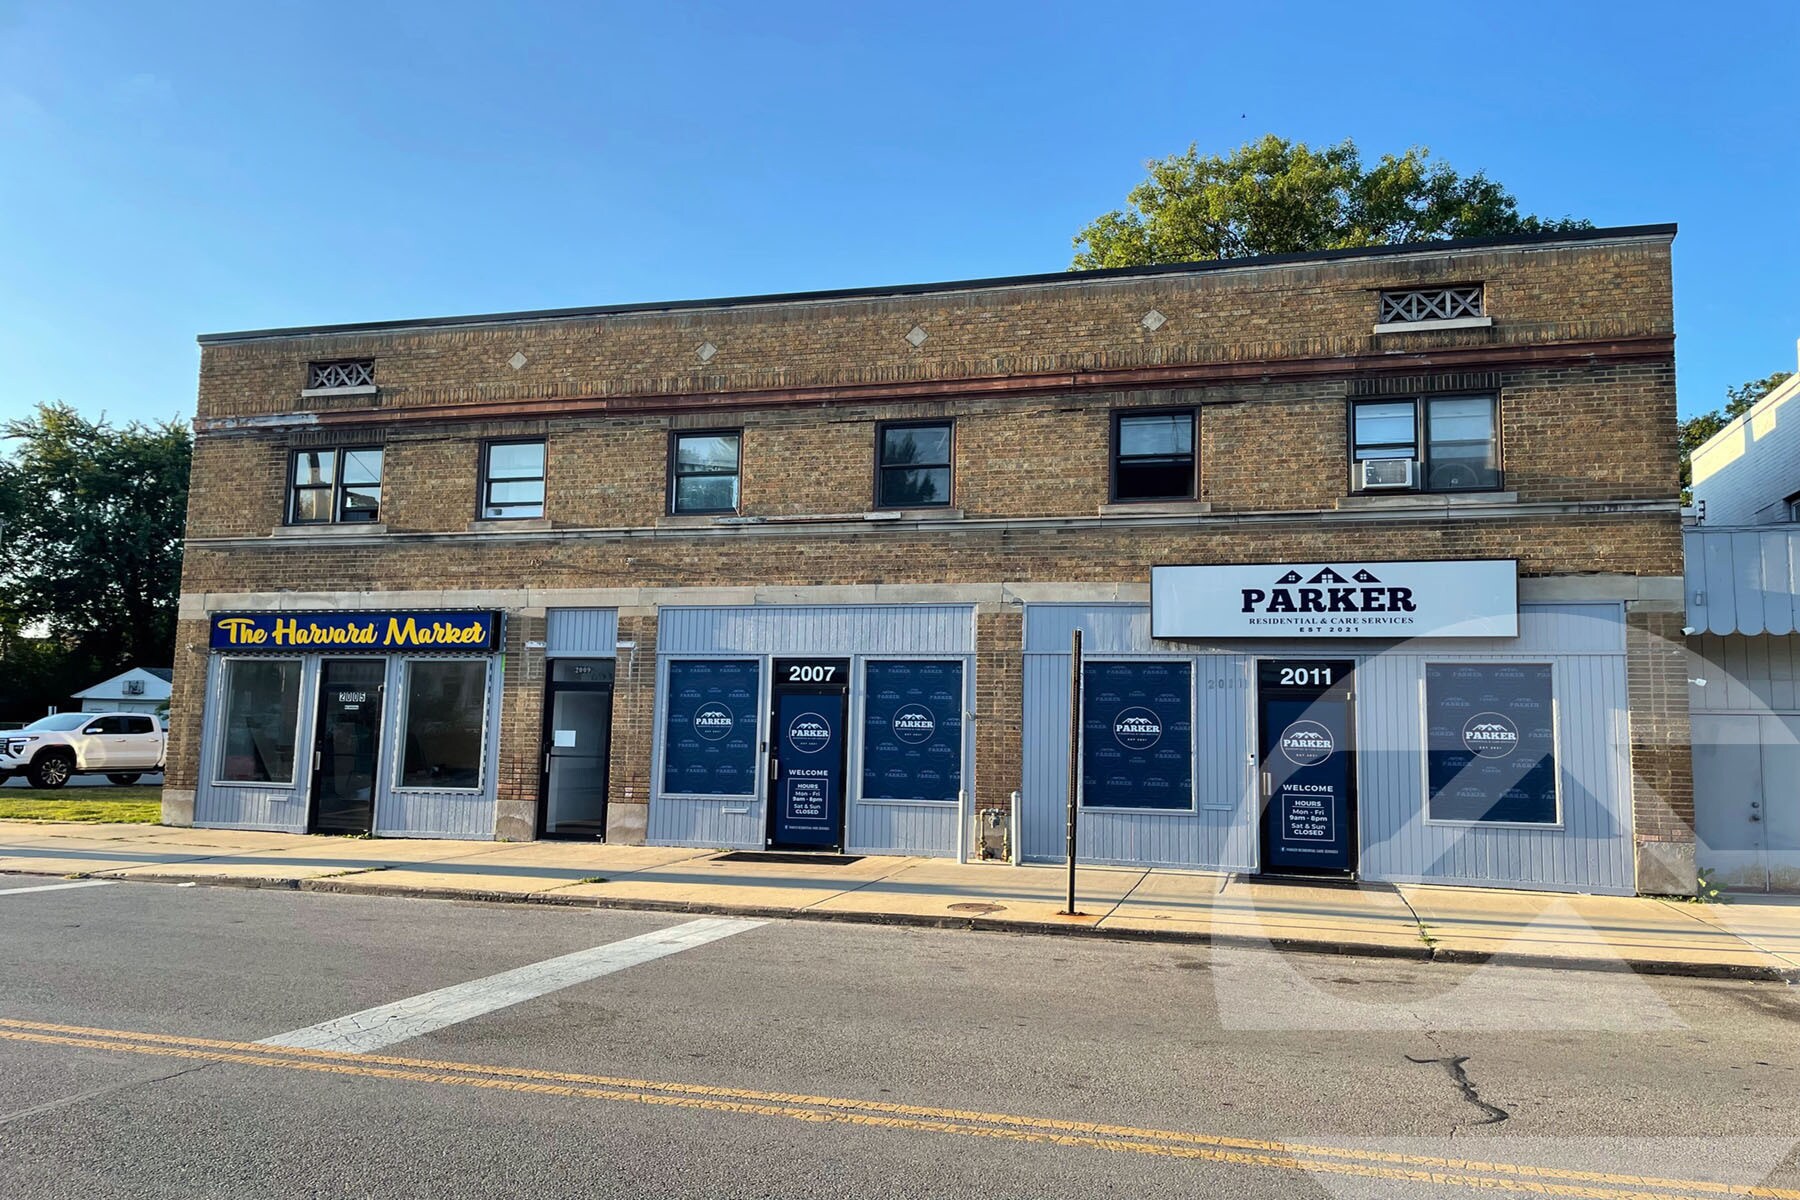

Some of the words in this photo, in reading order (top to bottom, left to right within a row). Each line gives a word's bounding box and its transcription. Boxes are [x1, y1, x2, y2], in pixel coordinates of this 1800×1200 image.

[1241, 587, 1417, 613] PARKER
[1249, 617, 1318, 625] RESIDENTIAL
[1330, 617, 1360, 625] CARE
[218, 617, 267, 645] The
[272, 618, 379, 646] Harvard
[383, 617, 487, 646] Market
[789, 666, 836, 682] 2007
[1280, 668, 1332, 685] 2011
[1116, 724, 1160, 732] PARKER
[1466, 732, 1516, 740] PARKER
[1284, 740, 1332, 748] PARKER
